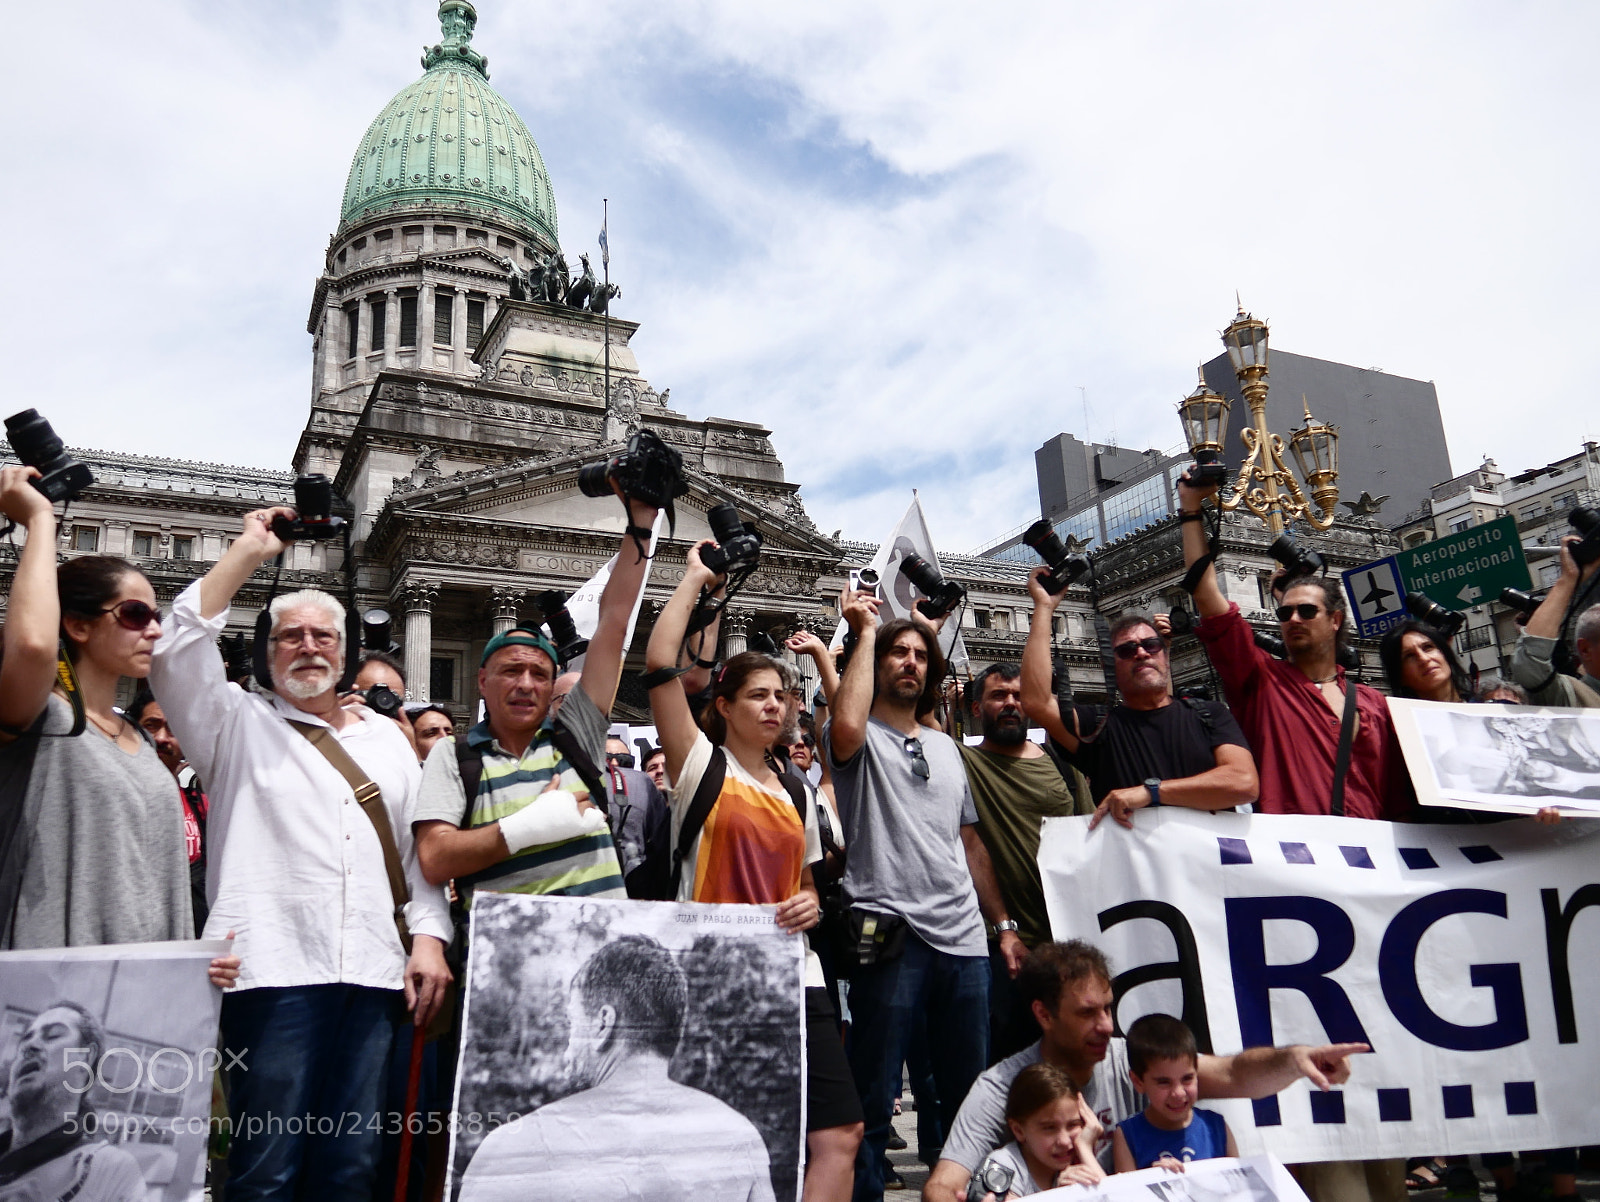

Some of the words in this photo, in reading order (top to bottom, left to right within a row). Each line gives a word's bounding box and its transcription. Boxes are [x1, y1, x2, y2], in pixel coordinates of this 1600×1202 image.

[1412, 528, 1503, 568] Aeropuerto
[649, 567, 685, 582] ACIO
[1410, 545, 1516, 590] Internacional
[675, 914, 698, 923] JUAN
[703, 915, 732, 924] PABLO
[737, 915, 777, 925] BARRIE
